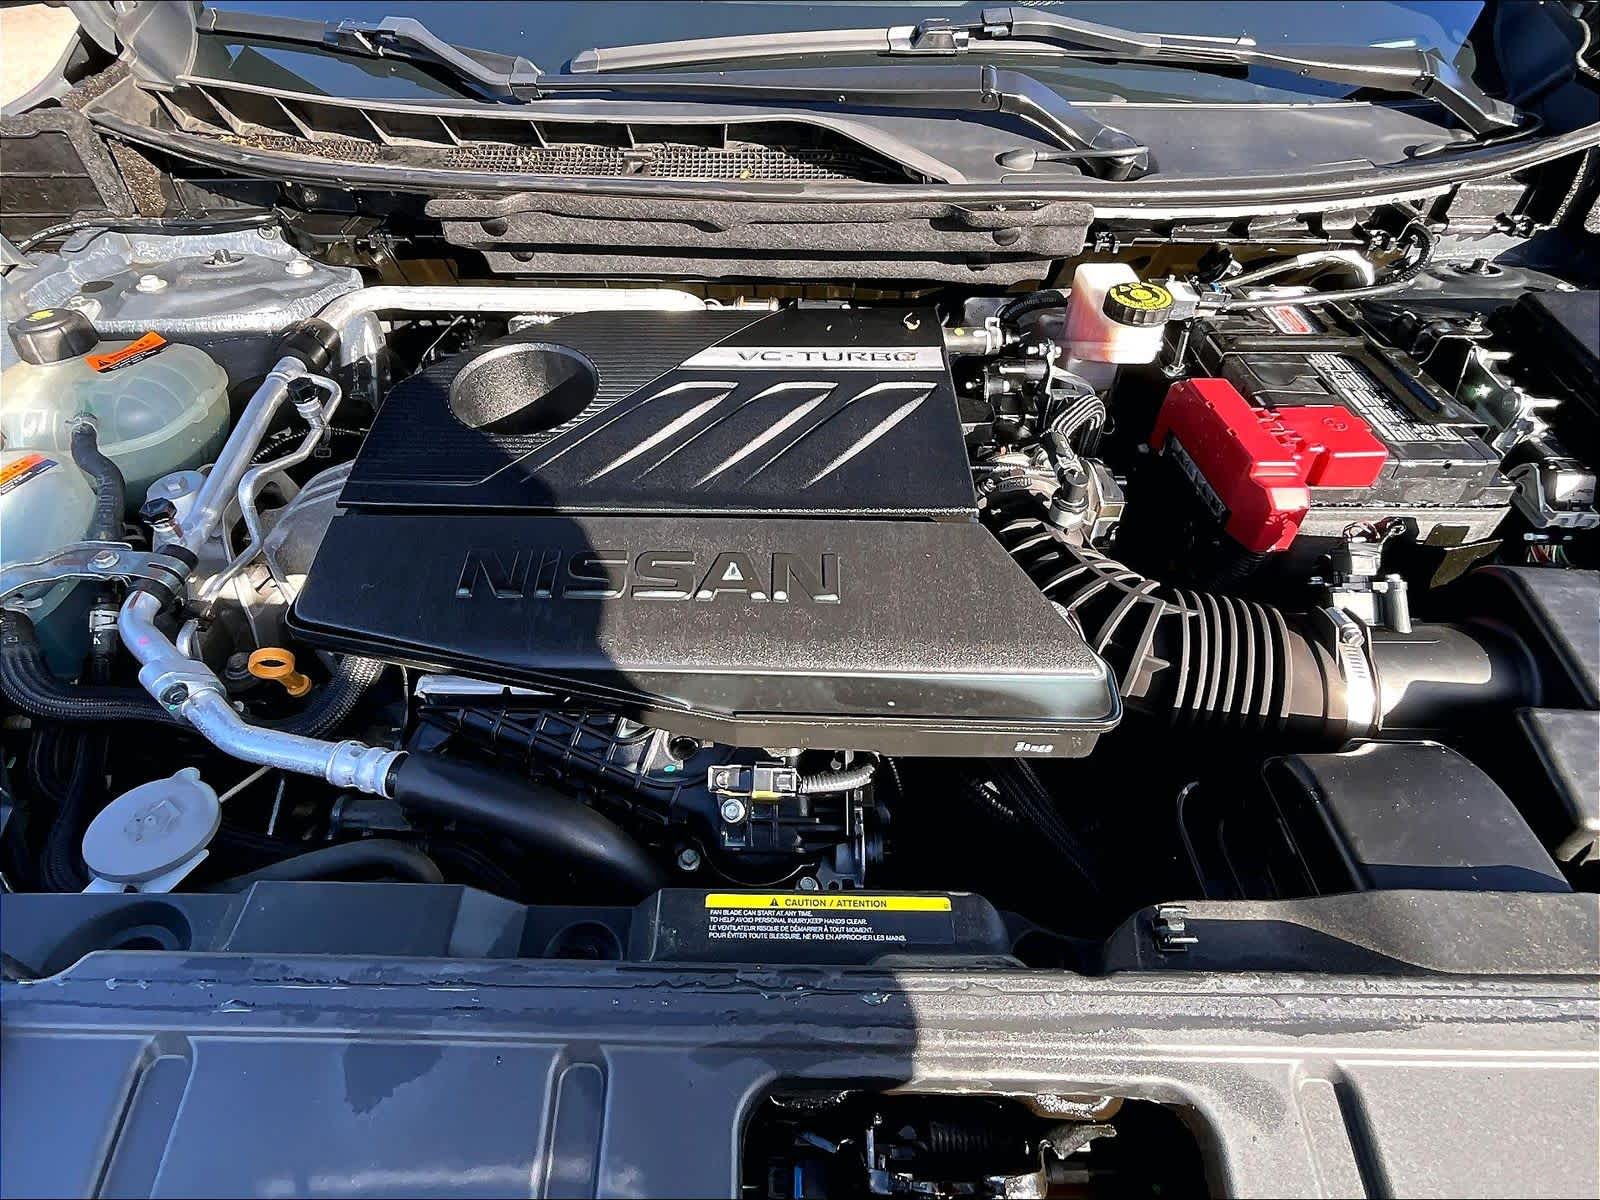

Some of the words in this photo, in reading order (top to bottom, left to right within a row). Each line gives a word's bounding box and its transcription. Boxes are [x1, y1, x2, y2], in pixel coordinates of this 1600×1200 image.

[736, 351, 919, 361] VC-TURBO
[455, 550, 841, 604] NISSAN
[784, 898, 826, 907] CAUTION
[836, 899, 888, 908] ATTENTION
[757, 909, 775, 917] START
[784, 909, 798, 917] ANY
[734, 916, 754, 924] AVOID
[754, 916, 787, 924] PERSONAL
[717, 924, 757, 932] VENTILATEUR
[789, 924, 824, 933] DÉMARRER
[726, 930, 748, 939] ÉVITER
[834, 933, 873, 941] APPROCHER
